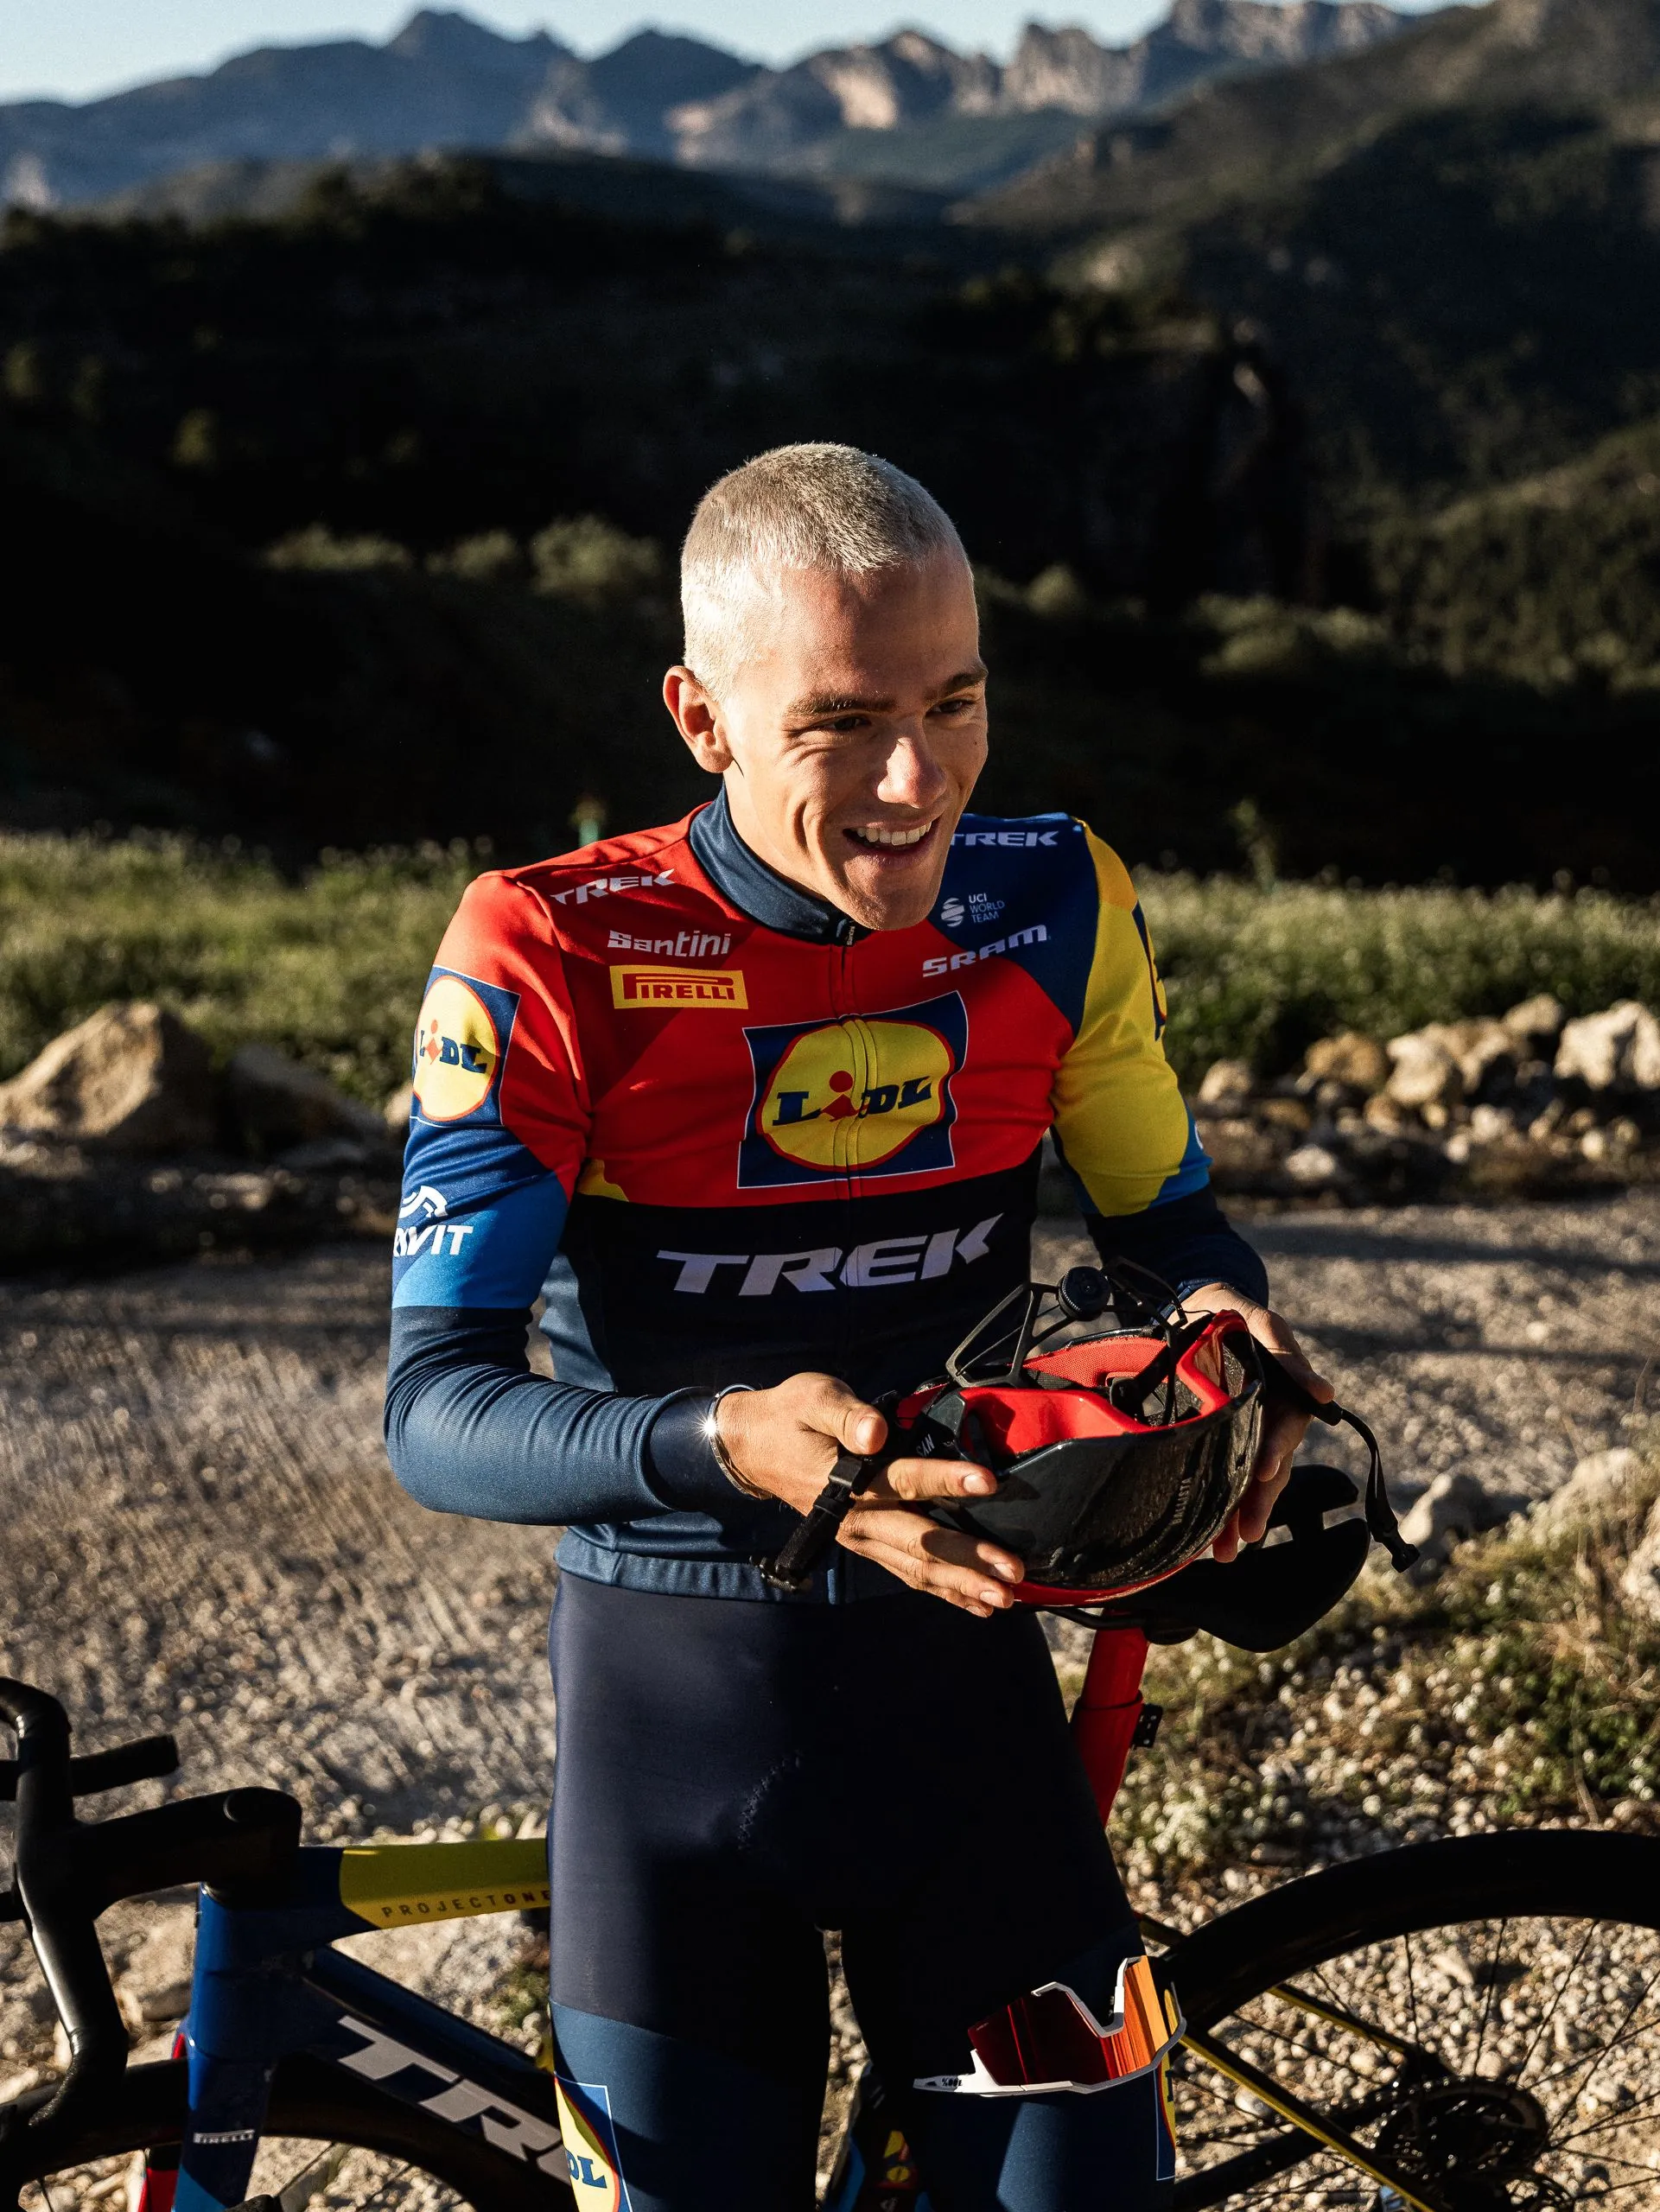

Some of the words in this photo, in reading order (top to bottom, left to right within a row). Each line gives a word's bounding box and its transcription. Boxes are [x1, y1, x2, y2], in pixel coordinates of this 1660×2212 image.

[550, 868, 675, 905] TREK
[969, 893, 987, 904] UCI
[970, 900, 1005, 912] WORLD
[971, 911, 999, 924] TEAM
[607, 930, 731, 957] Santini
[923, 925, 1047, 977] SRAM
[622, 974, 735, 1000] PIRELLI
[657, 1213, 1004, 1296] TREK
[194, 2129, 255, 2144] PIRELLI
